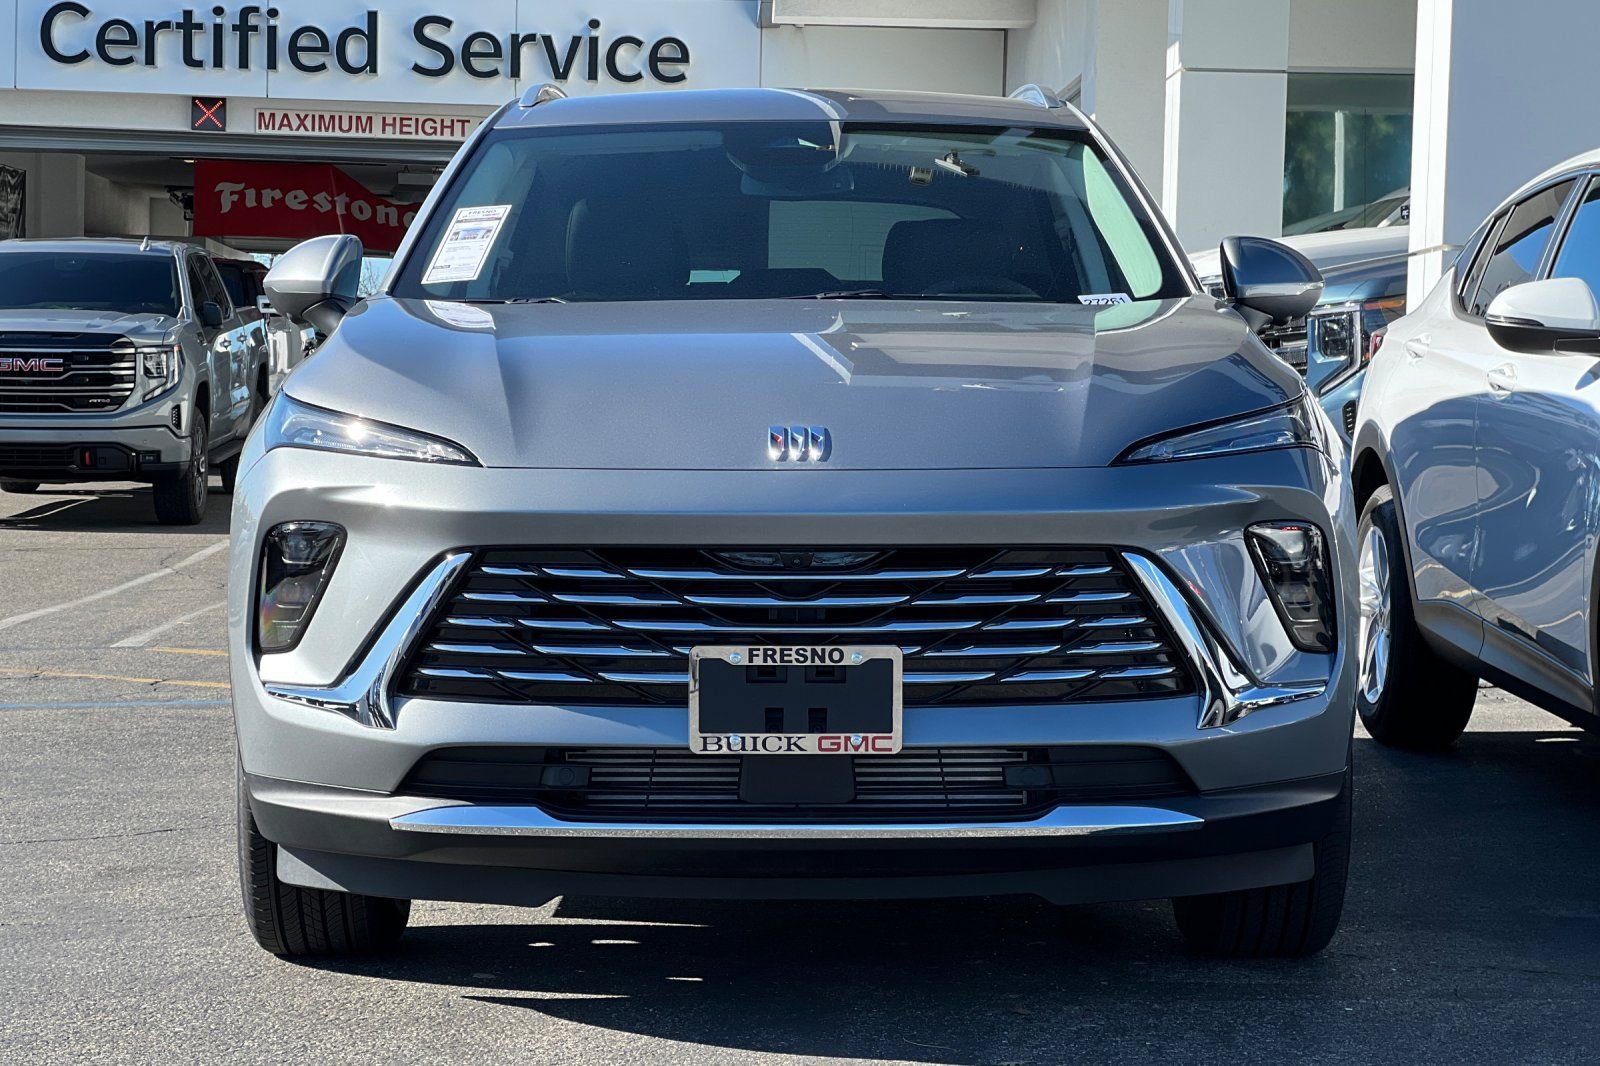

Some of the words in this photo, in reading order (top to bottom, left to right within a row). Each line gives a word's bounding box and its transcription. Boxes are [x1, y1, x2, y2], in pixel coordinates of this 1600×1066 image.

[40, 1, 379, 76] Certified
[411, 15, 691, 83] Service
[257, 111, 373, 134] MAXIMUM
[381, 115, 471, 138] HEIGHT
[747, 647, 845, 664] FRESNO
[700, 735, 808, 752] BUICK
[817, 735, 893, 752] GMC
